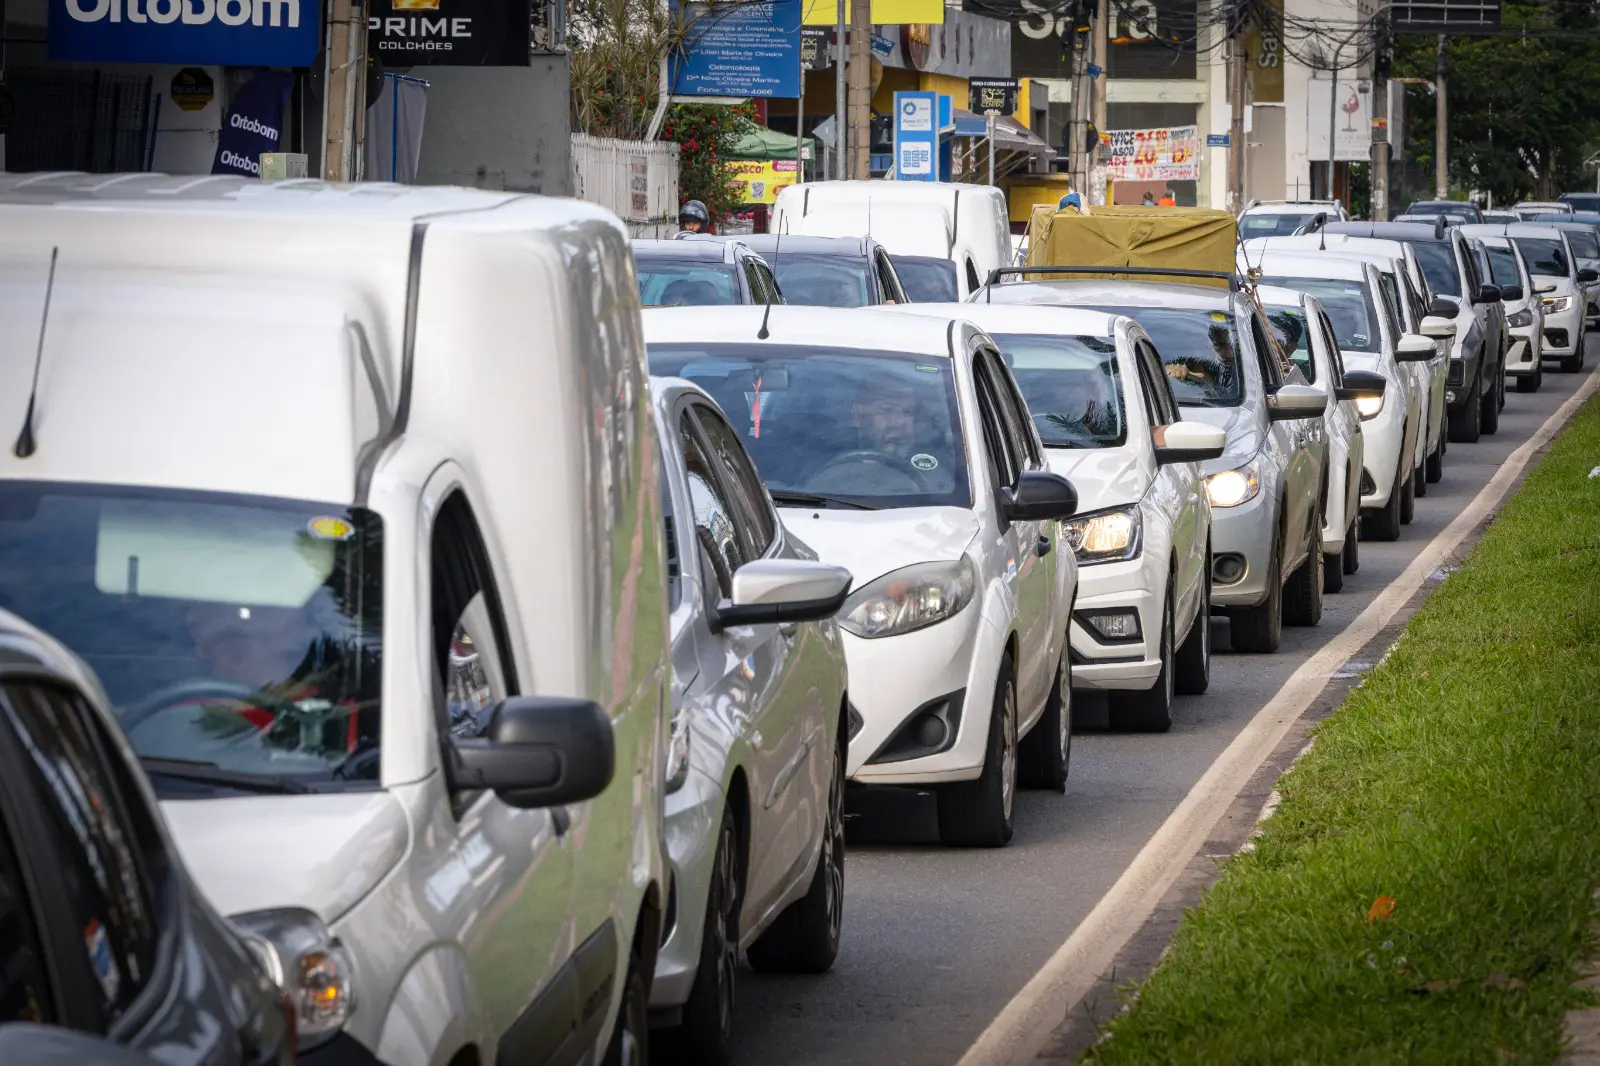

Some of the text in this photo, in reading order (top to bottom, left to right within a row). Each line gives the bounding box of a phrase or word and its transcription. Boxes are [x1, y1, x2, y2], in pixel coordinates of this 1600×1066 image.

[368, 17, 472, 37] PRIME
[379, 41, 453, 50] COLCHÕES
[708, 64, 760, 72] Odontologia
[230, 113, 279, 141] Ortobom
[1112, 147, 1135, 157] ASCO
[220, 150, 261, 177] Ortobo
